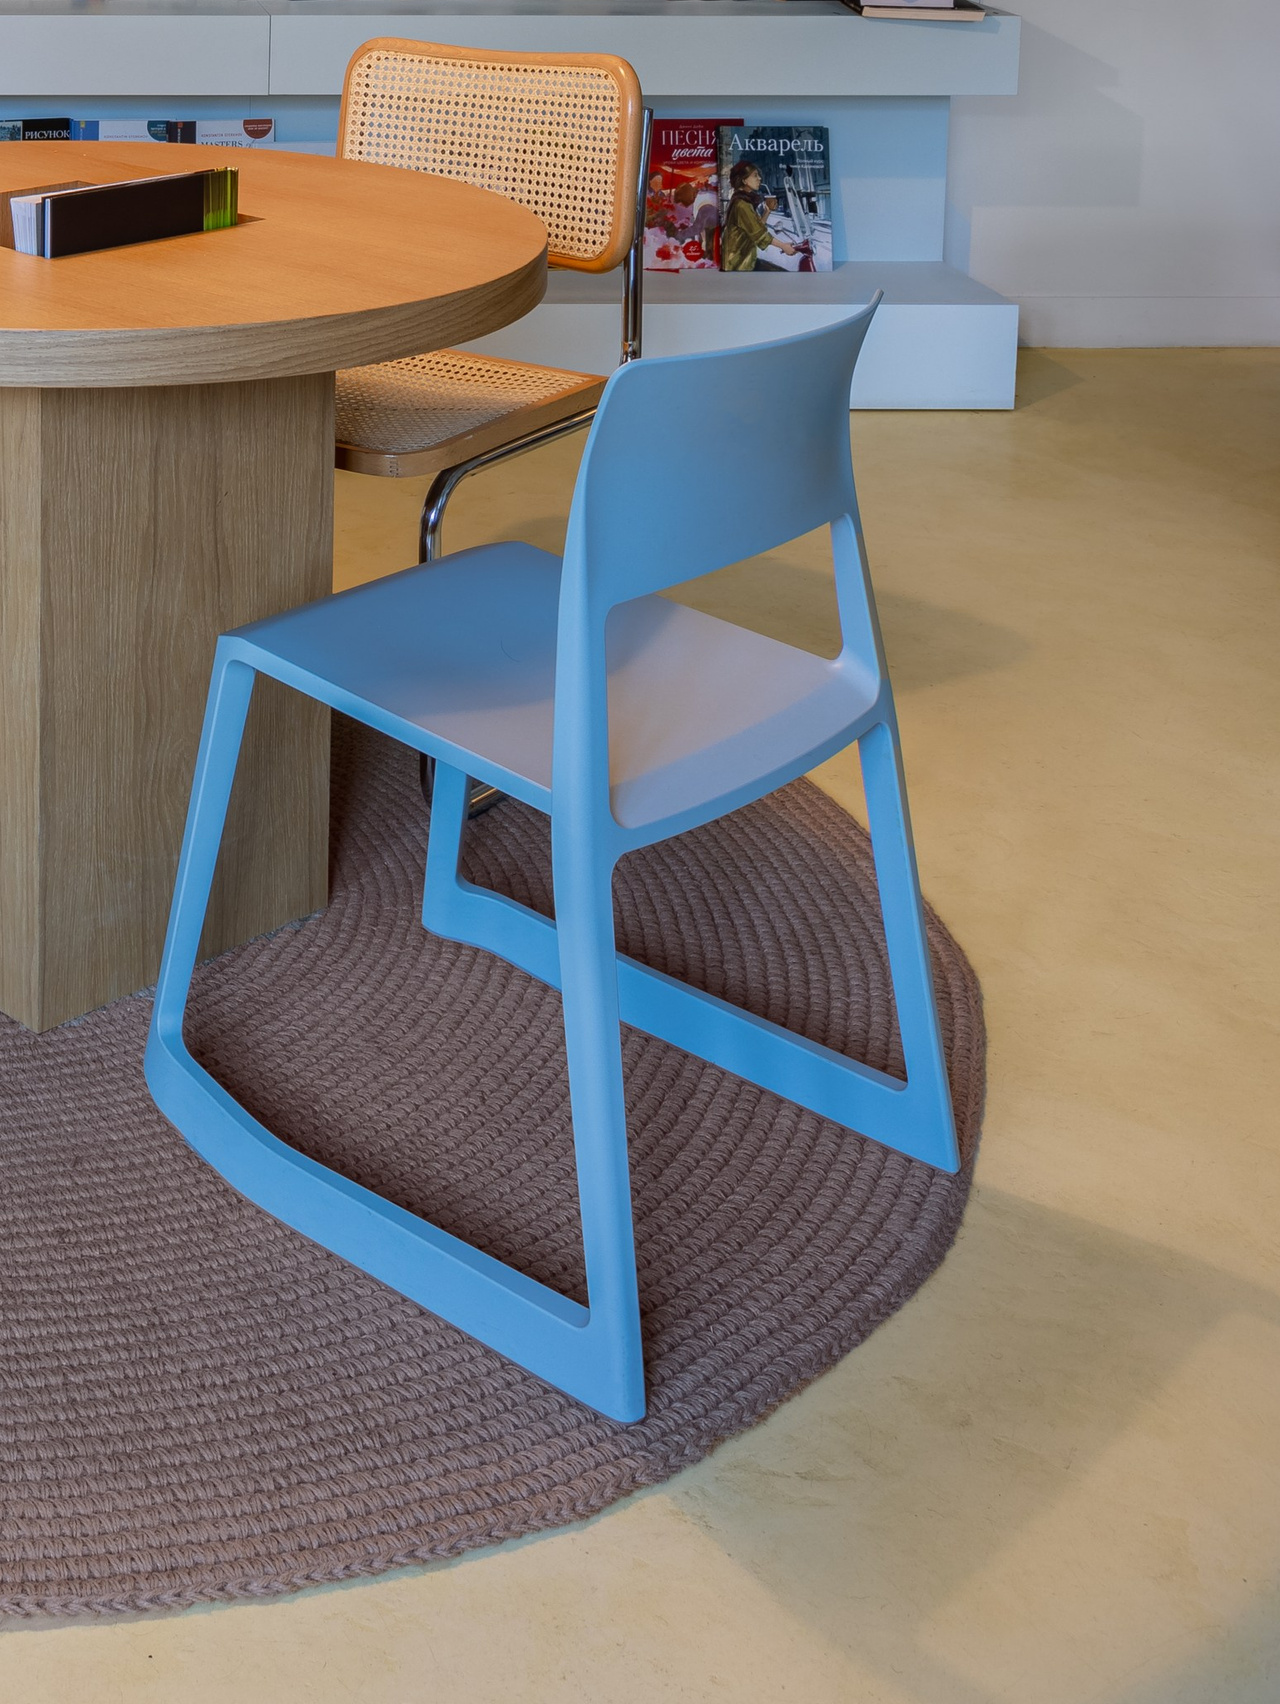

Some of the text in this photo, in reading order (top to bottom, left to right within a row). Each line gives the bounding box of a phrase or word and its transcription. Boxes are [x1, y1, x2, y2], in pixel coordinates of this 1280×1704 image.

[25, 130, 70, 140] РИСУНОК
[728, 133, 824, 156] Акварель
[672, 146, 713, 161] цвета
